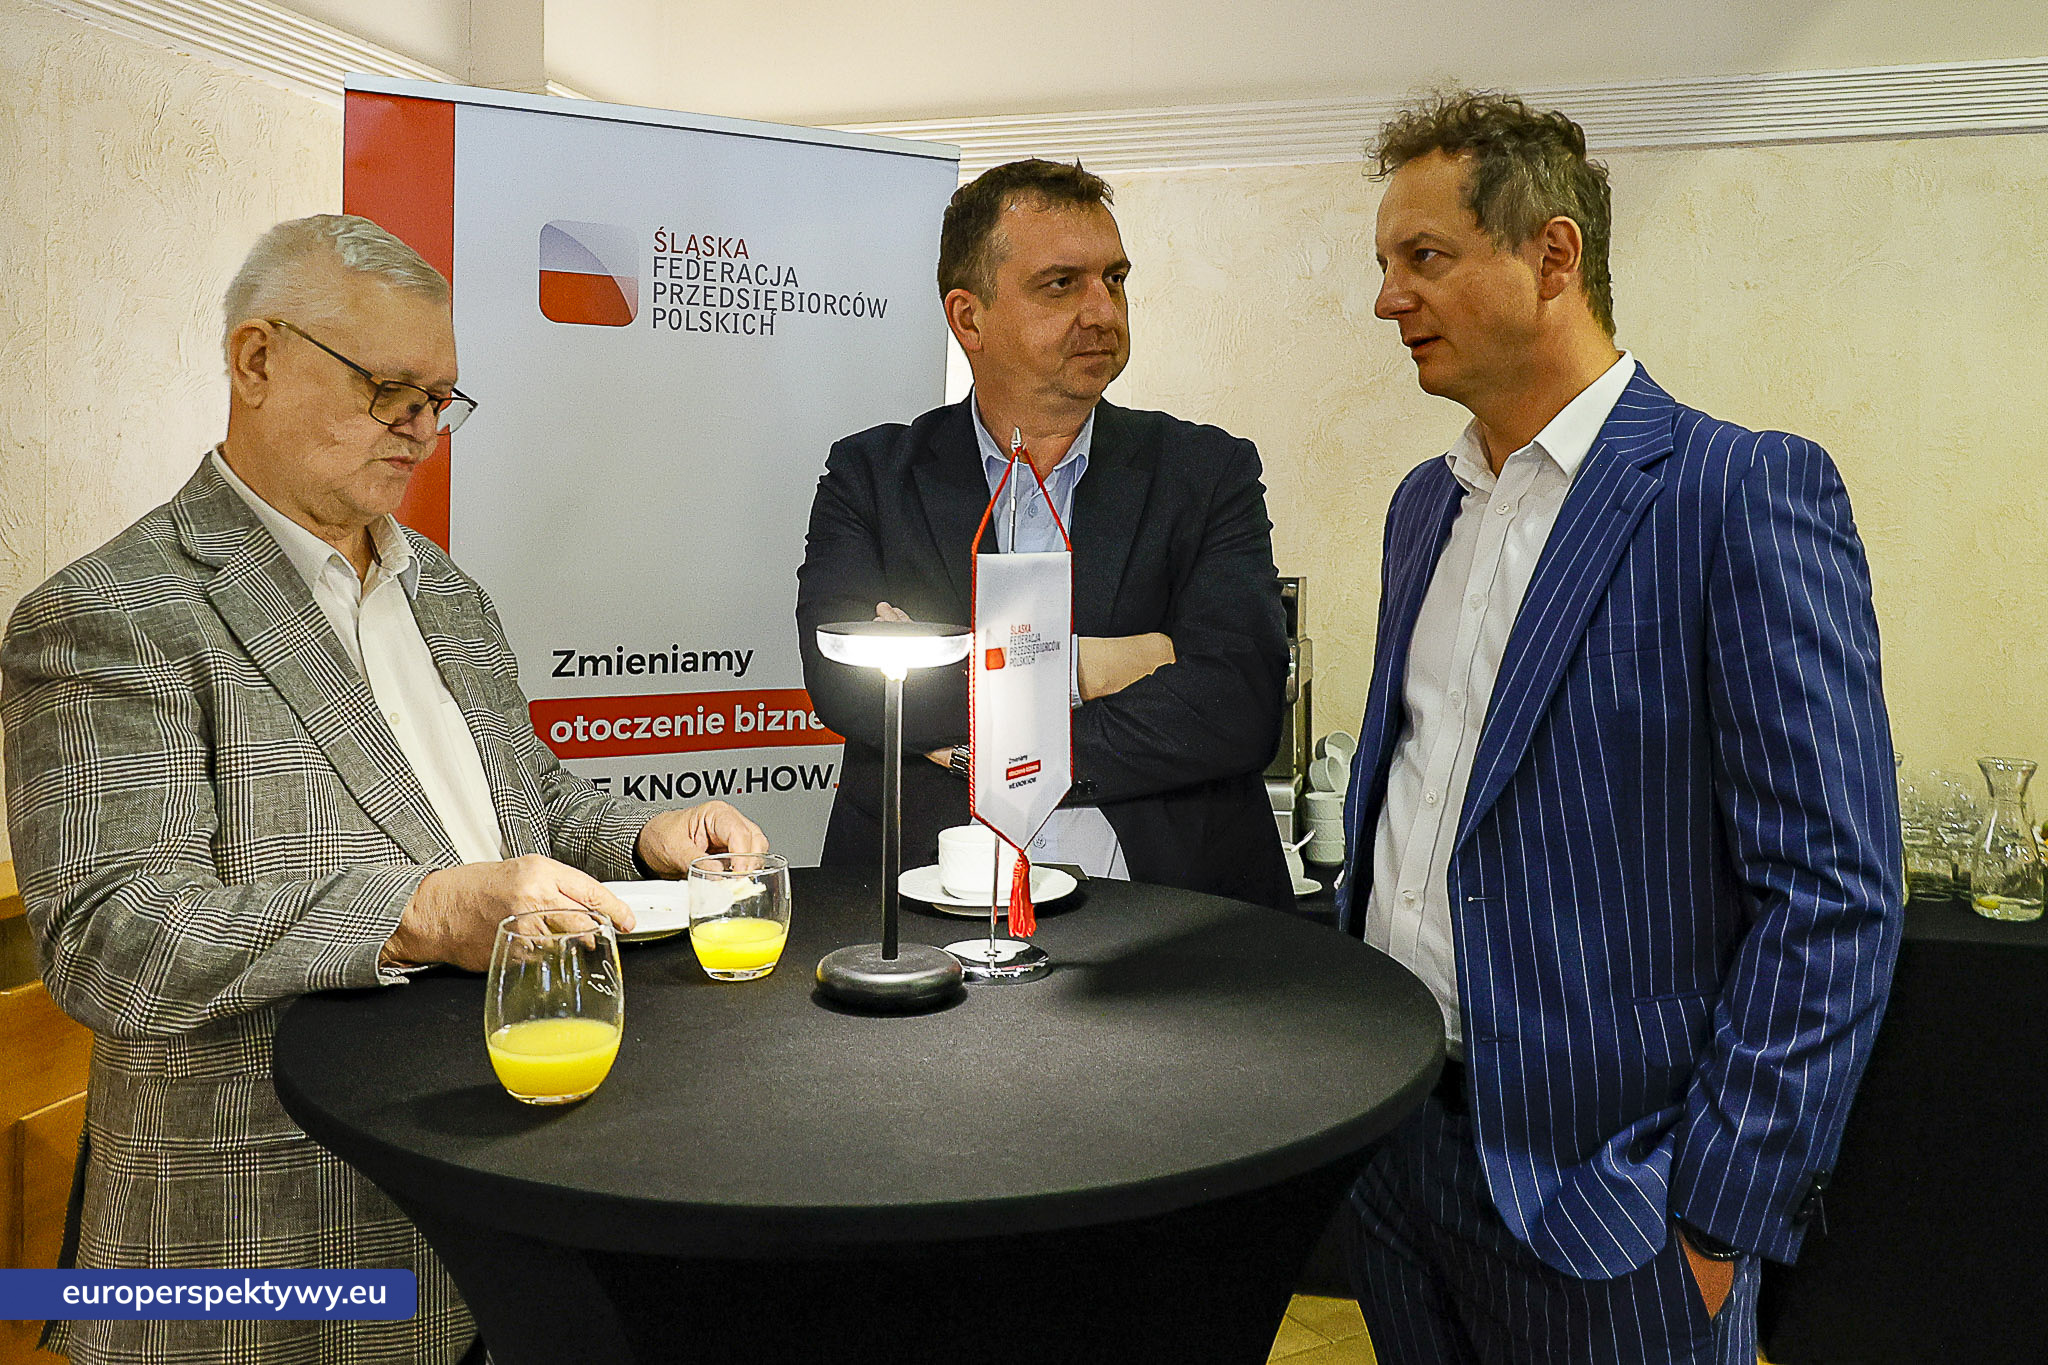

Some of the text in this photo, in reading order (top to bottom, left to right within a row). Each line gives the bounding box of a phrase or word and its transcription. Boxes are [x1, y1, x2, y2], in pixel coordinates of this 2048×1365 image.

[653, 226, 749, 260] ŚLĄSKA
[653, 256, 799, 288] FEDERACJA
[652, 282, 888, 319] PRZEDSIĘBIORCÓW
[652, 308, 775, 336] POLSKICH
[551, 643, 754, 678] Zmieniamy
[550, 702, 826, 743] otoczenie bizne
